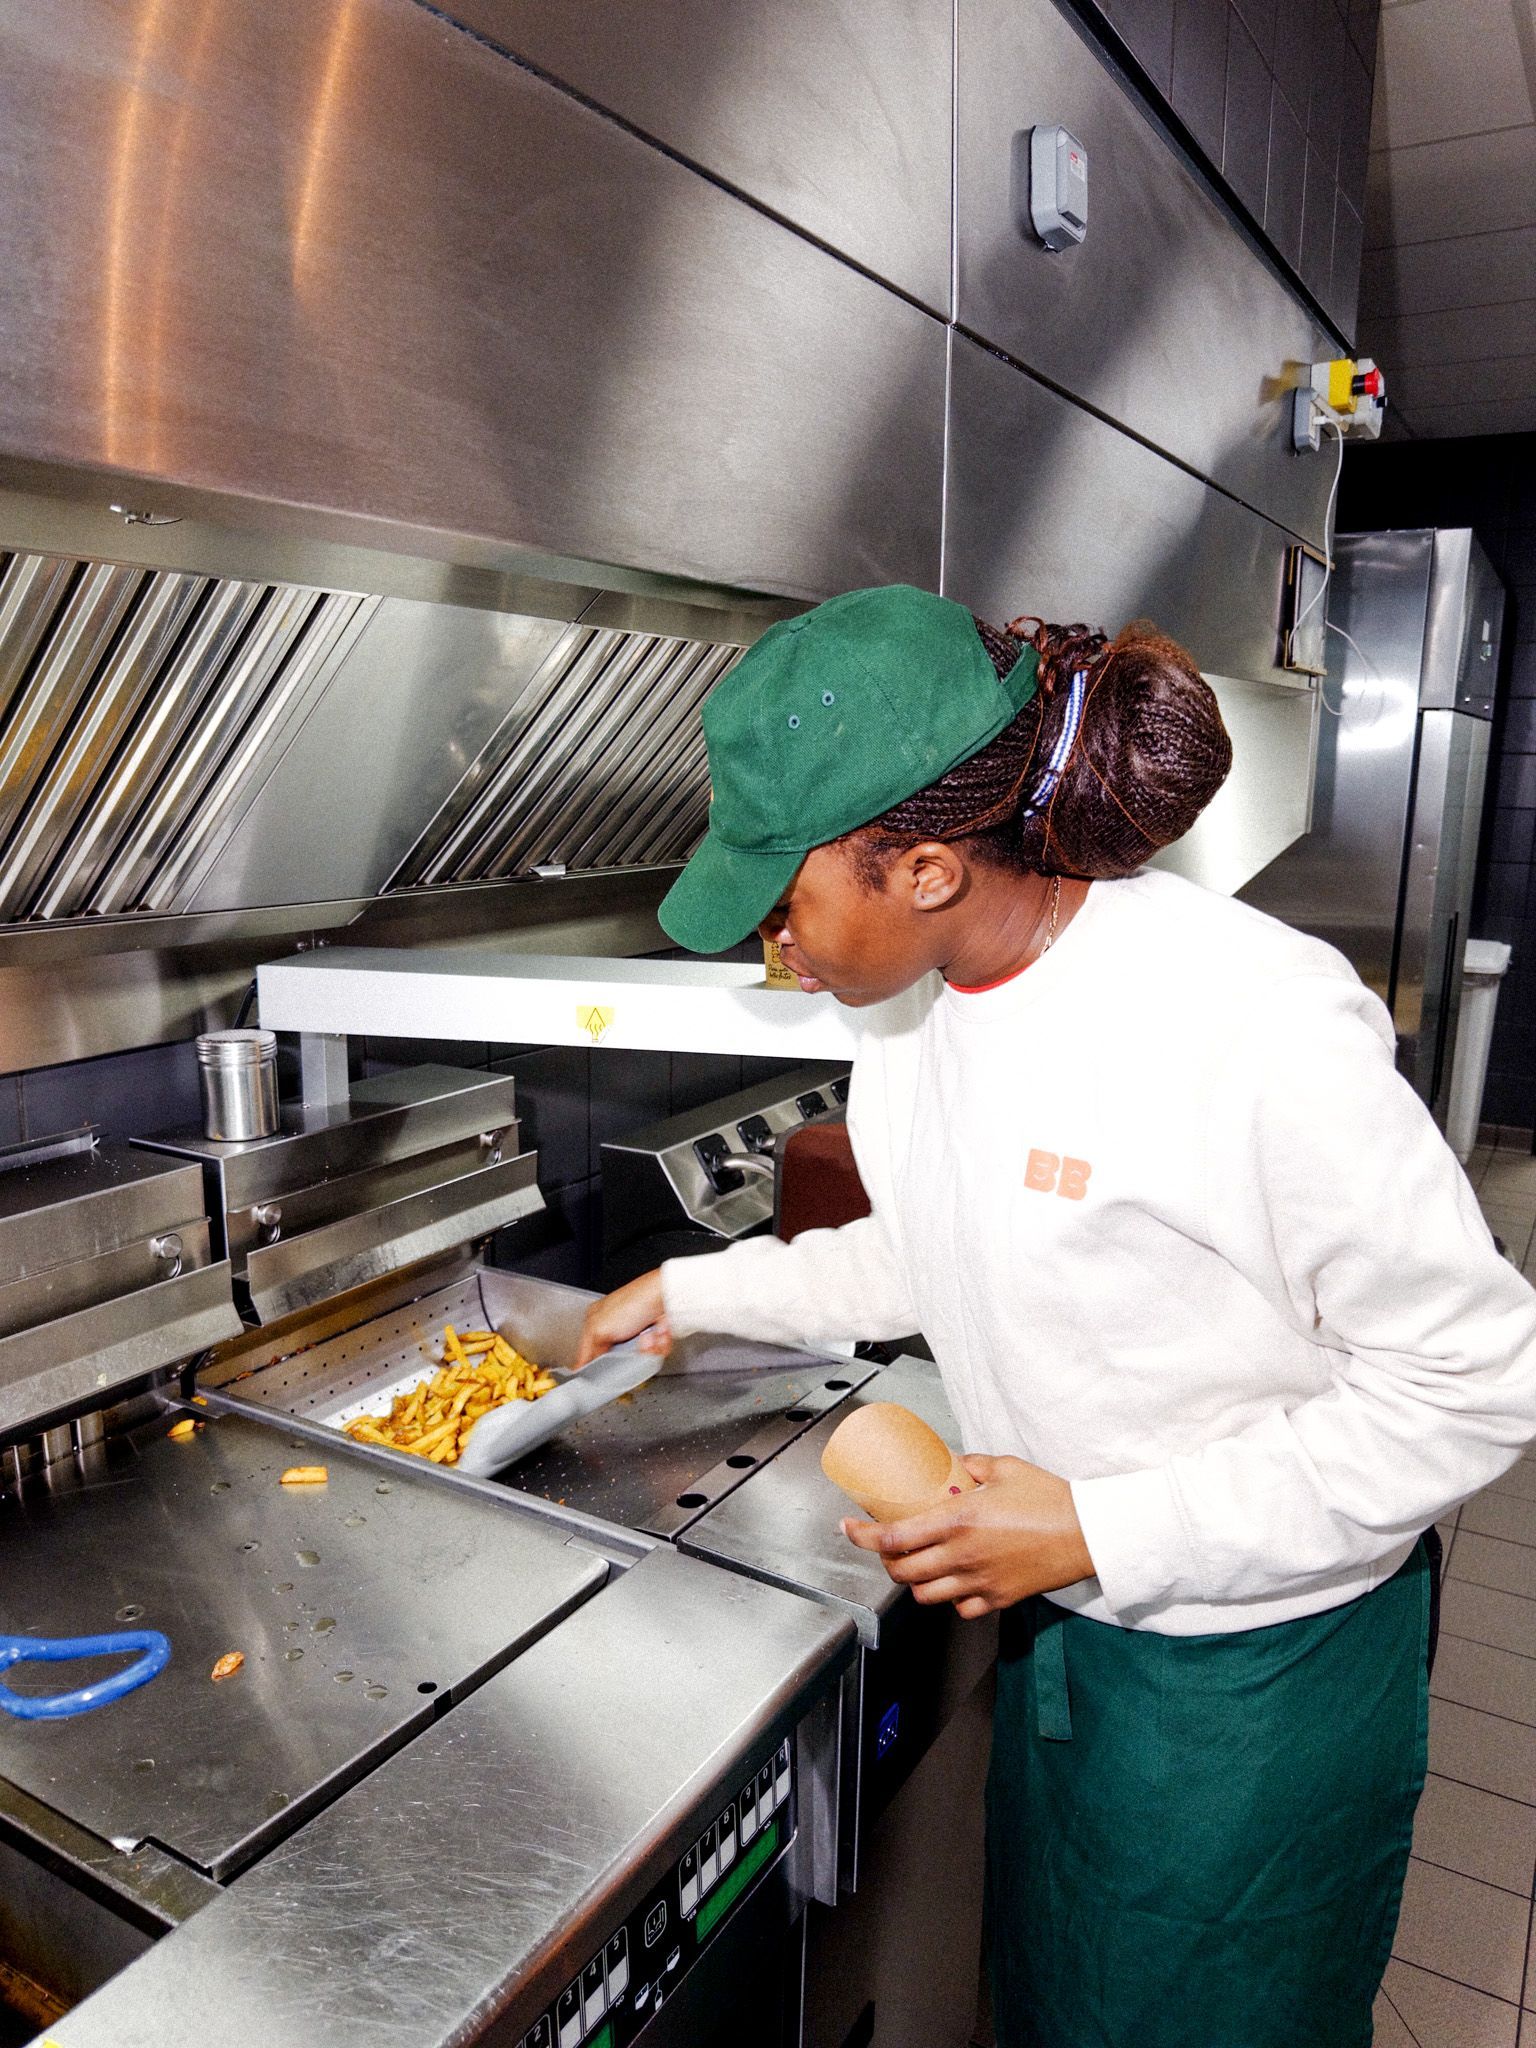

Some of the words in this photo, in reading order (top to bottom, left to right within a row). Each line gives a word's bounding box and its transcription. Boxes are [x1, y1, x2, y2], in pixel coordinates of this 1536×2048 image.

[1024, 1148, 1092, 1201] BB
[685, 1854, 692, 1868] 6
[705, 1831, 711, 1846] 7
[723, 1811, 730, 1824] 8
[745, 1786, 751, 1799] 9
[779, 1748, 785, 1761] R
[533, 2025, 541, 2042] 2
[566, 1989, 573, 2005] 3
[589, 1962, 597, 1976] 4
[613, 1935, 620, 1950] 5
